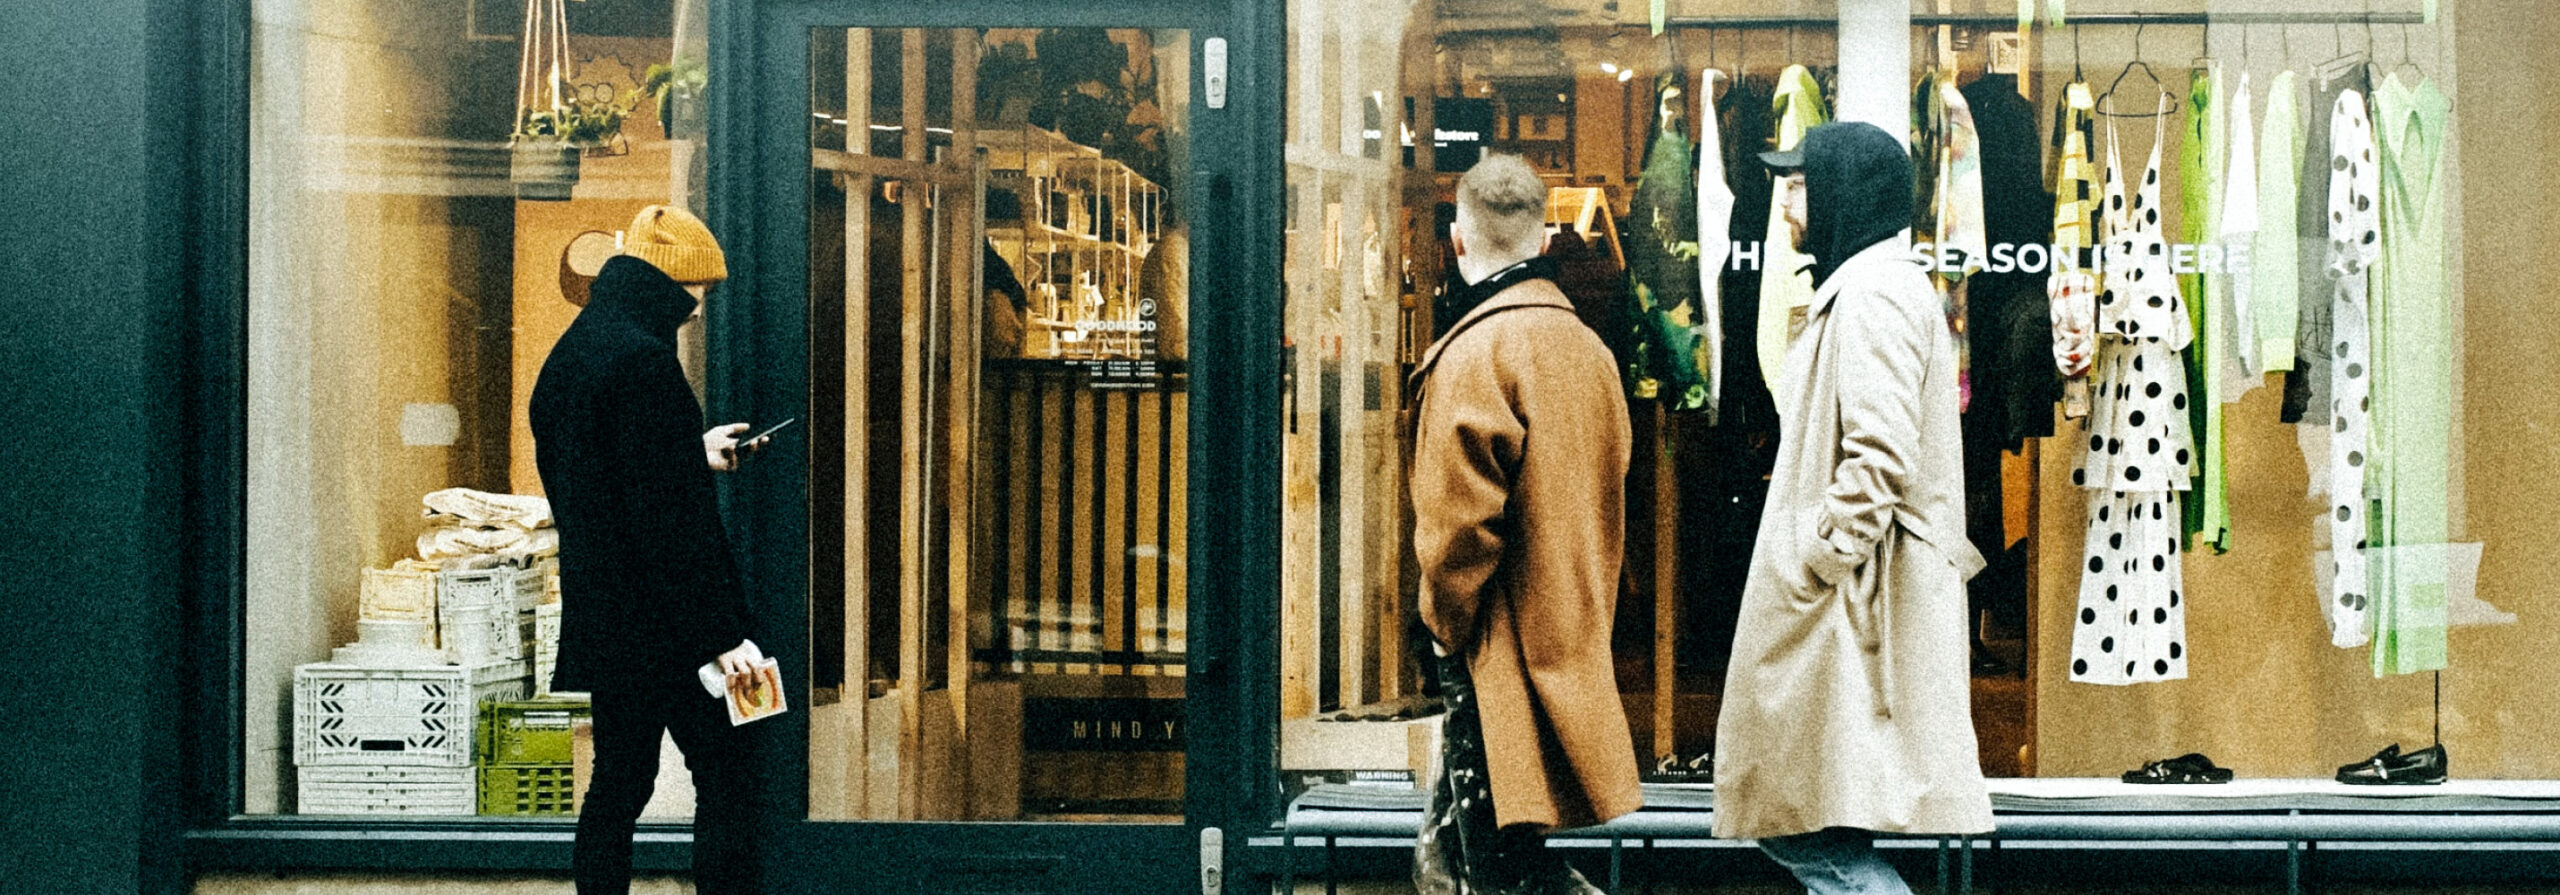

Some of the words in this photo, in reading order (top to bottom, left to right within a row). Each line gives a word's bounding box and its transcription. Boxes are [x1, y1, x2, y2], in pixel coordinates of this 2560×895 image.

[1910, 242, 2079, 273] SEASON
[1073, 721, 1141, 739] MIND
[1355, 771, 1409, 780] WARNING
